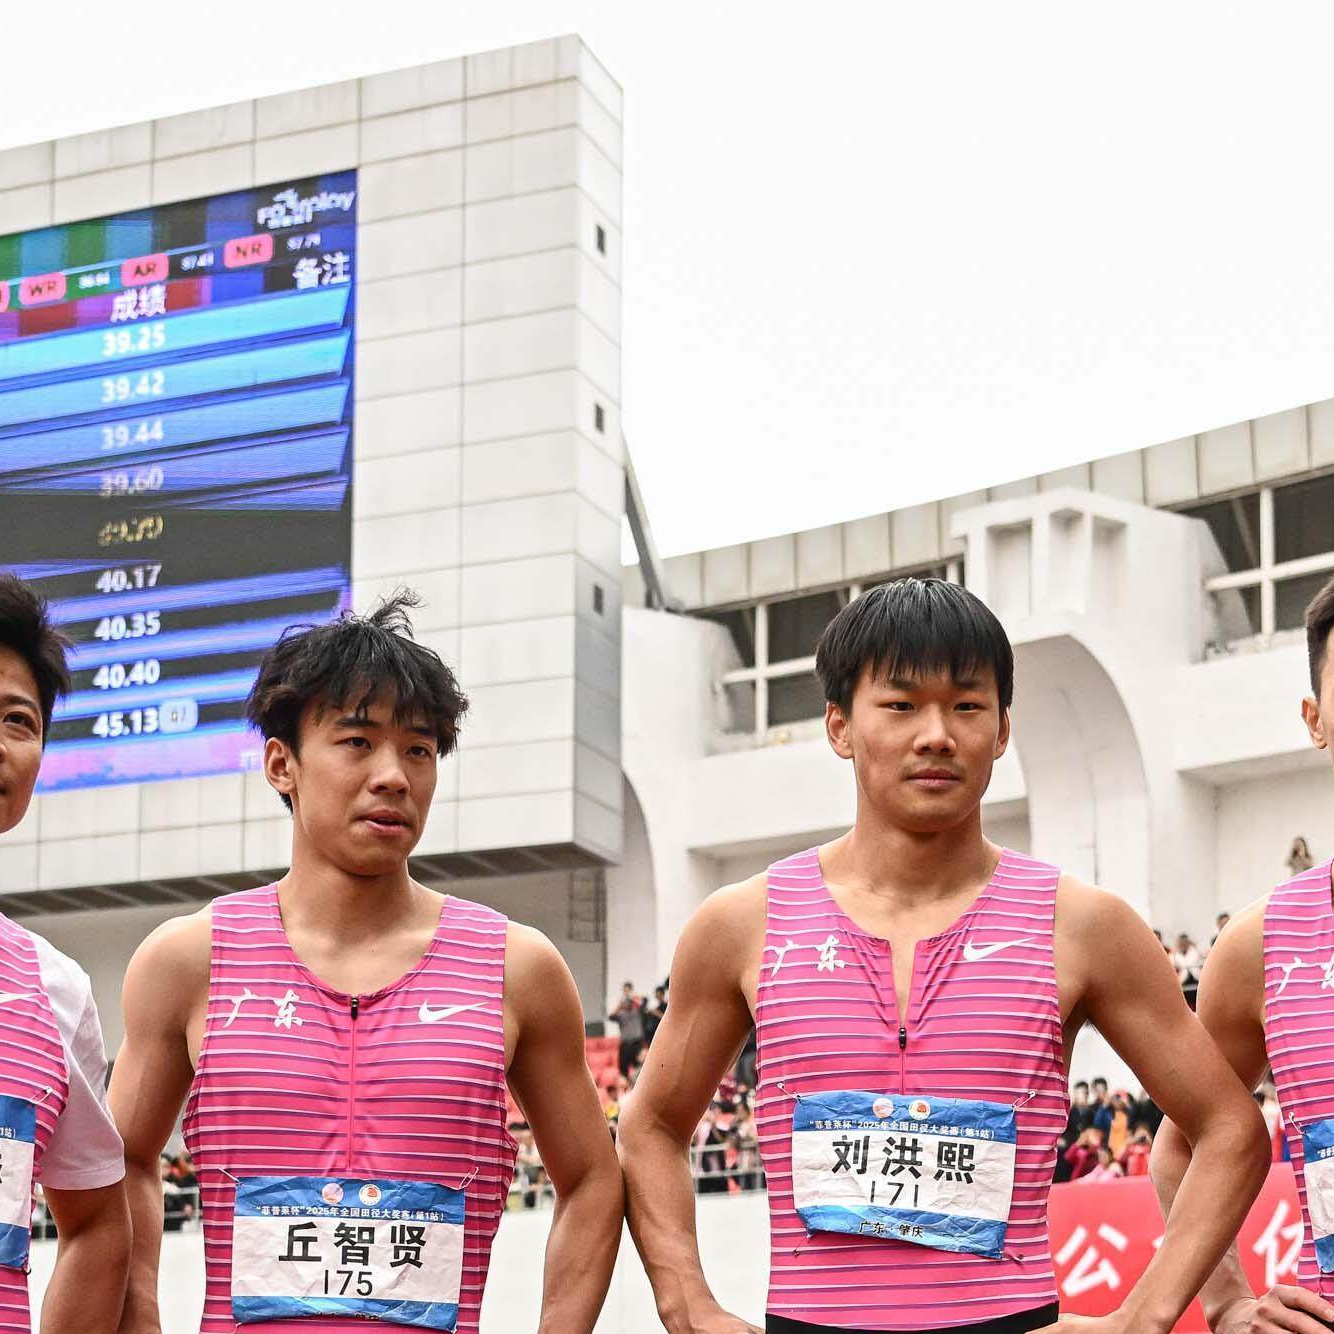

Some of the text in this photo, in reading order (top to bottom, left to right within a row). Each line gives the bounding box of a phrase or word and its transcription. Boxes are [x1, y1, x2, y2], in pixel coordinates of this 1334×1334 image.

[291, 251, 350, 291] 备注
[110, 283, 167, 322] 成绩
[103, 324, 165, 357] 39.25
[101, 370, 165, 403] 39.42
[101, 419, 164, 451] 39.44
[95, 562, 162, 593] 40.17
[94, 609, 161, 641] 40.35
[92, 658, 160, 689] 40.40
[92, 707, 158, 738] 45.13
[771, 935, 845, 977] 广东
[222, 987, 304, 1030] 广东
[831, 1134, 976, 1185] 刘洪熙
[870, 1180, 919, 1207] 171
[278, 1221, 427, 1269] 丘智贤
[323, 1269, 373, 1297] 175
